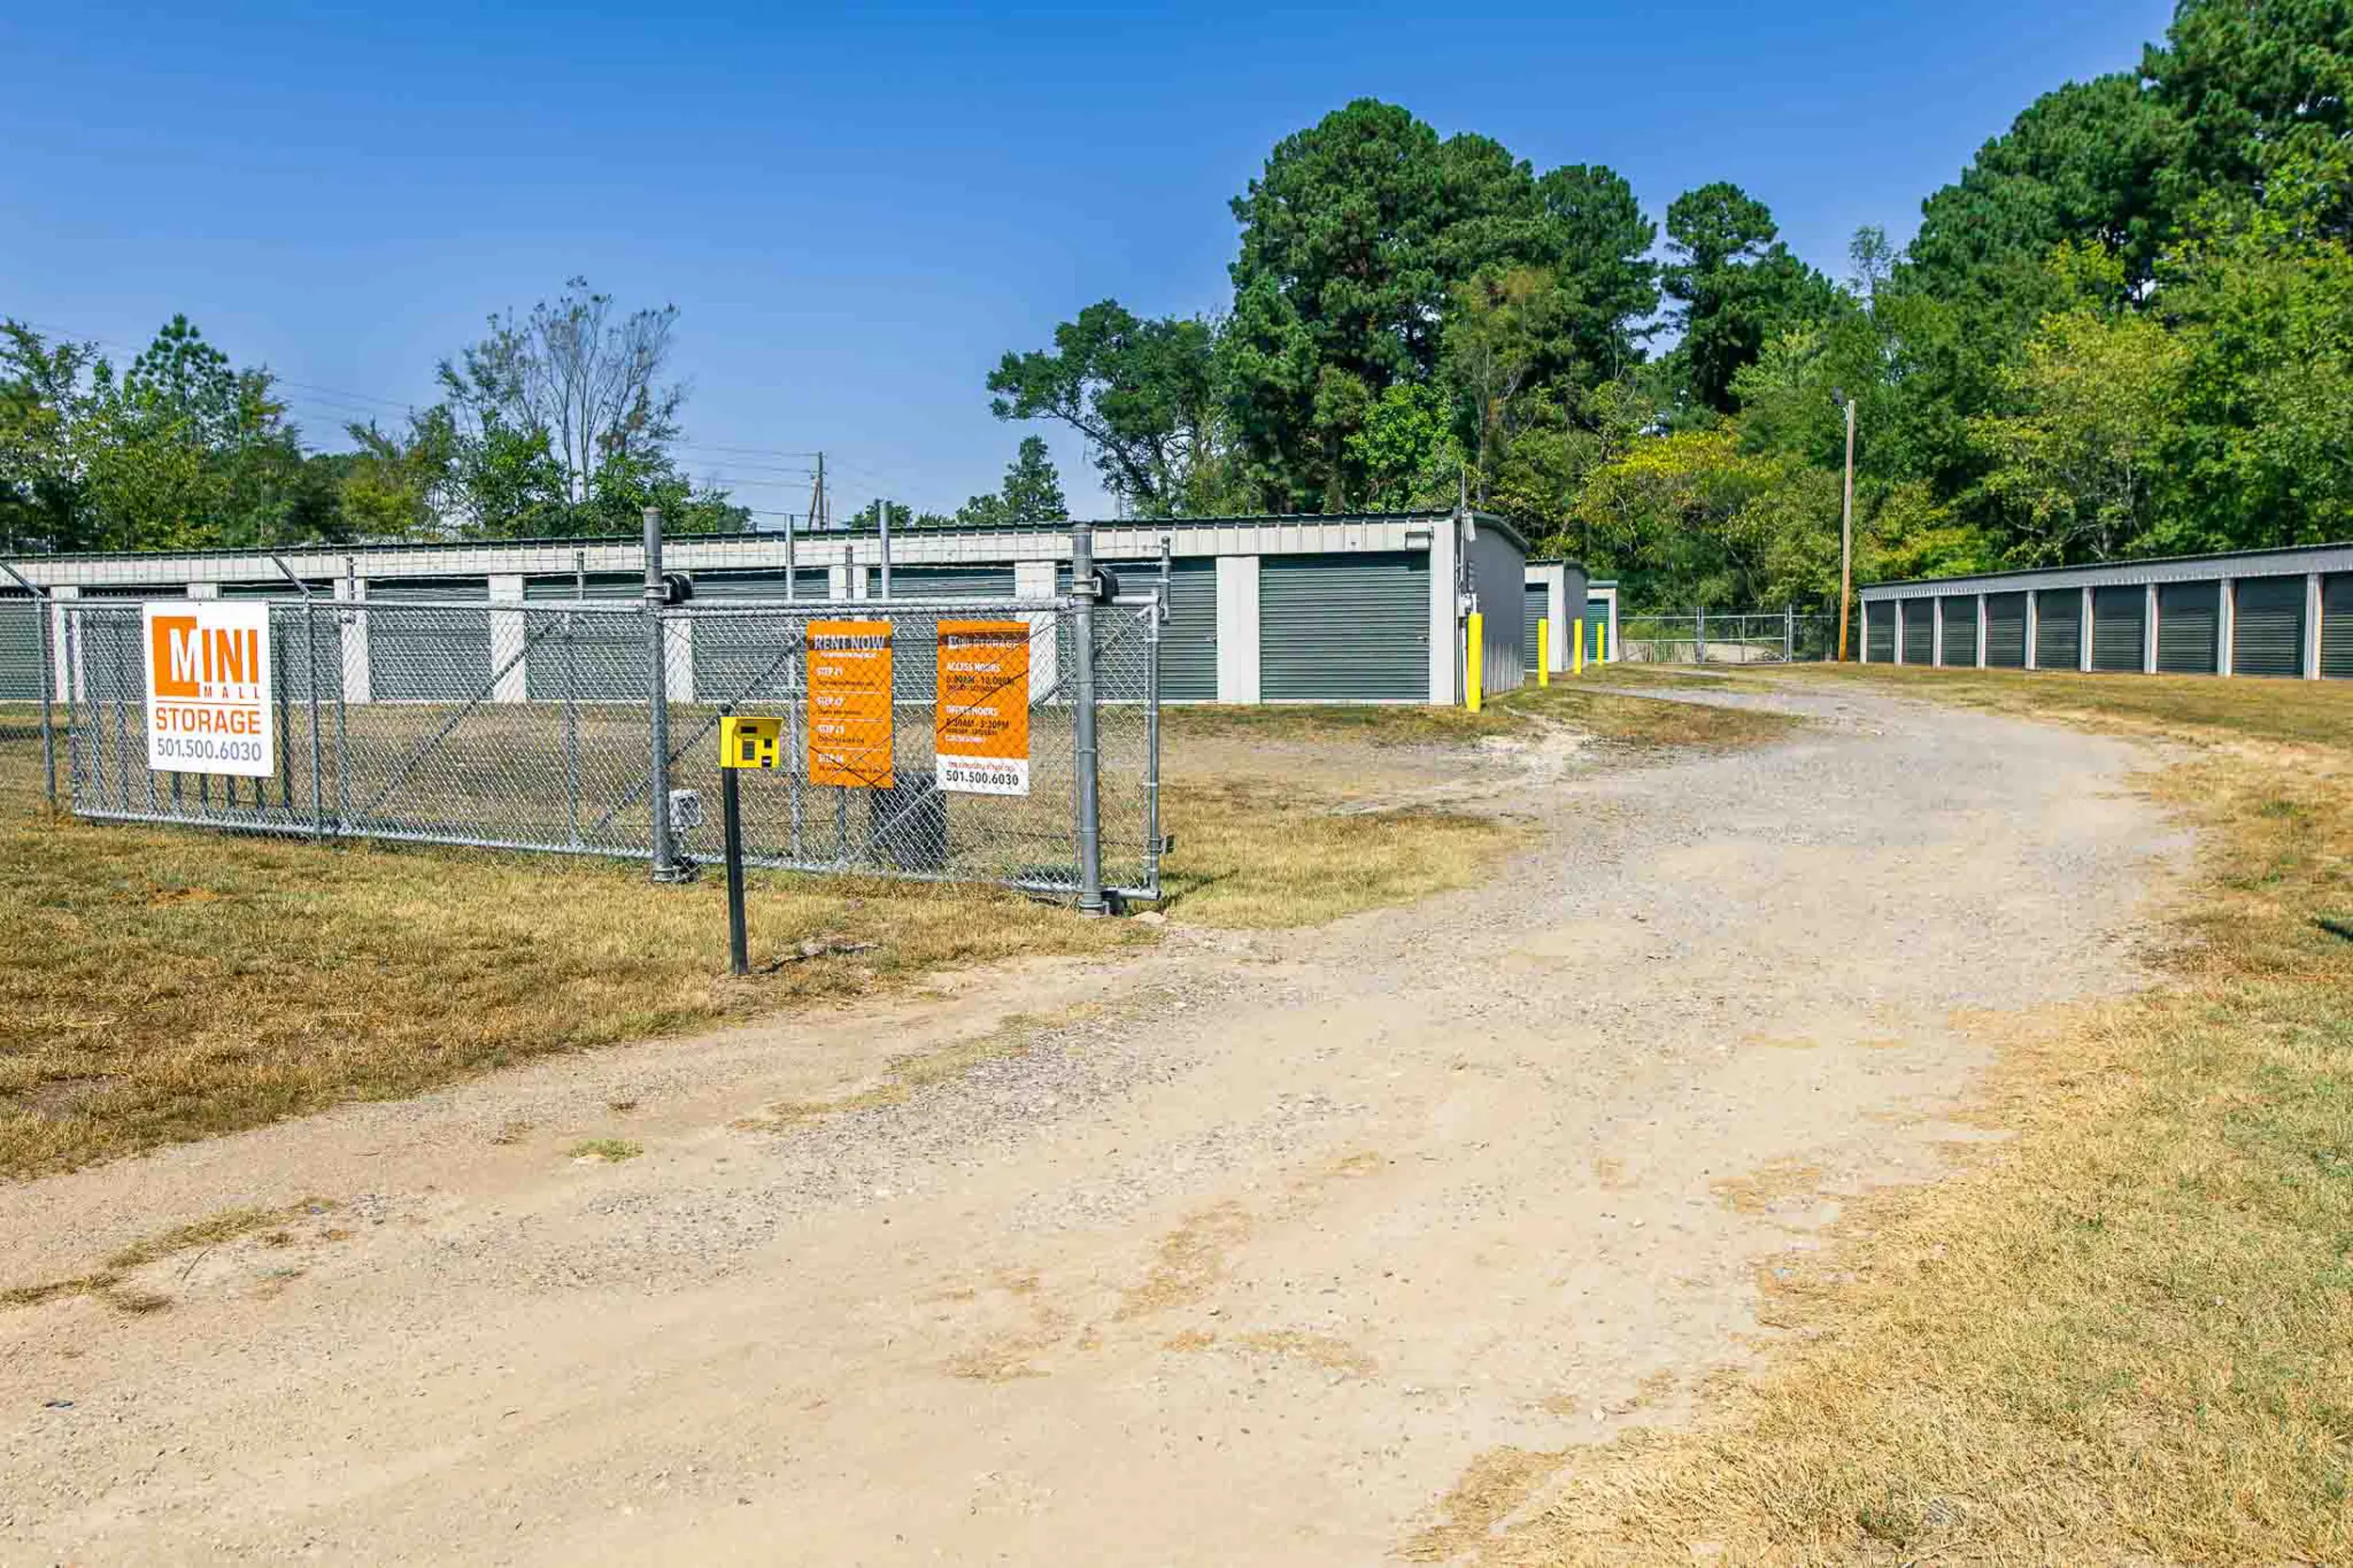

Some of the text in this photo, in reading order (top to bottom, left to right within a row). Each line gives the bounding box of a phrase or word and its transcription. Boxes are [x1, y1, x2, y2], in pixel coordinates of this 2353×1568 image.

[814, 634, 886, 650] RENT NOW
[169, 629, 259, 683] MINI
[946, 662, 973, 672] ACCESS
[204, 686, 260, 699] MALL
[156, 707, 261, 734] STORAGE
[157, 738, 263, 761] 501.500.6030
[946, 770, 1019, 786] 501.500.6030
